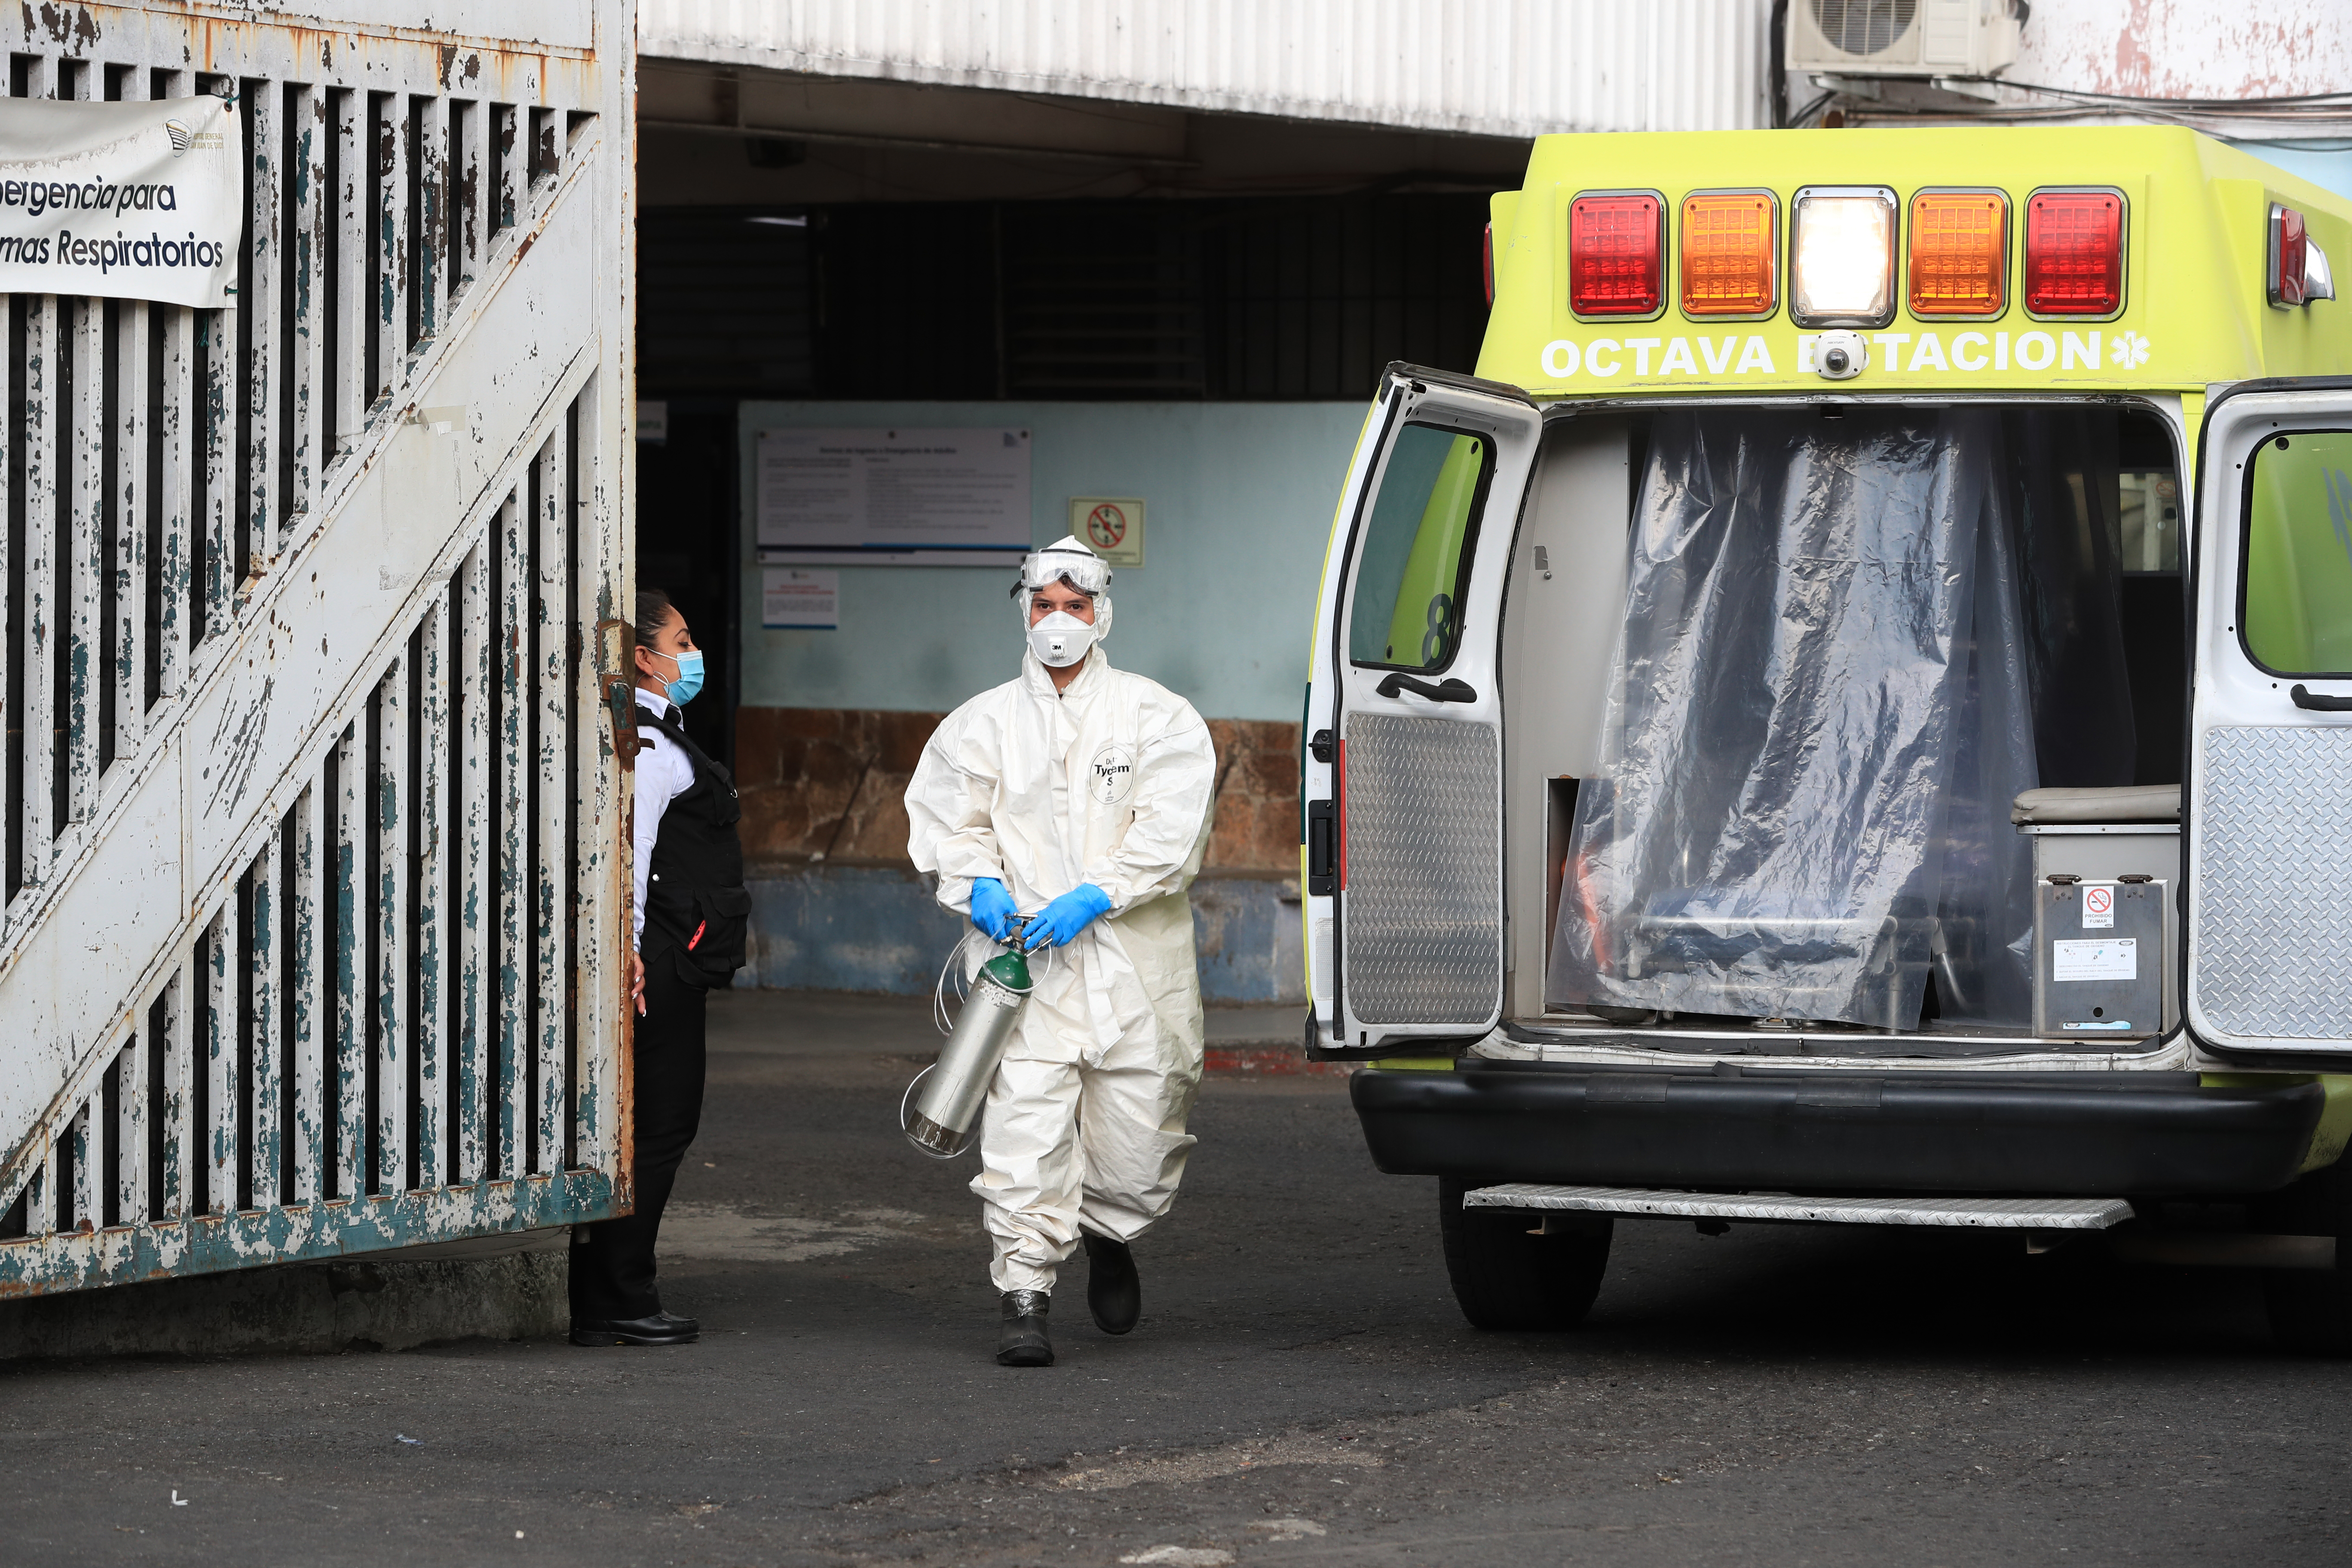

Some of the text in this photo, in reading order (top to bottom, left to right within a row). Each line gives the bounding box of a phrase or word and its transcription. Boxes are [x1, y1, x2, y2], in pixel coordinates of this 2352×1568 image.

[0, 175, 177, 218] ergencia para
[57, 230, 223, 275] Respiratorios
[1541, 336, 1776, 378] OCTAVA
